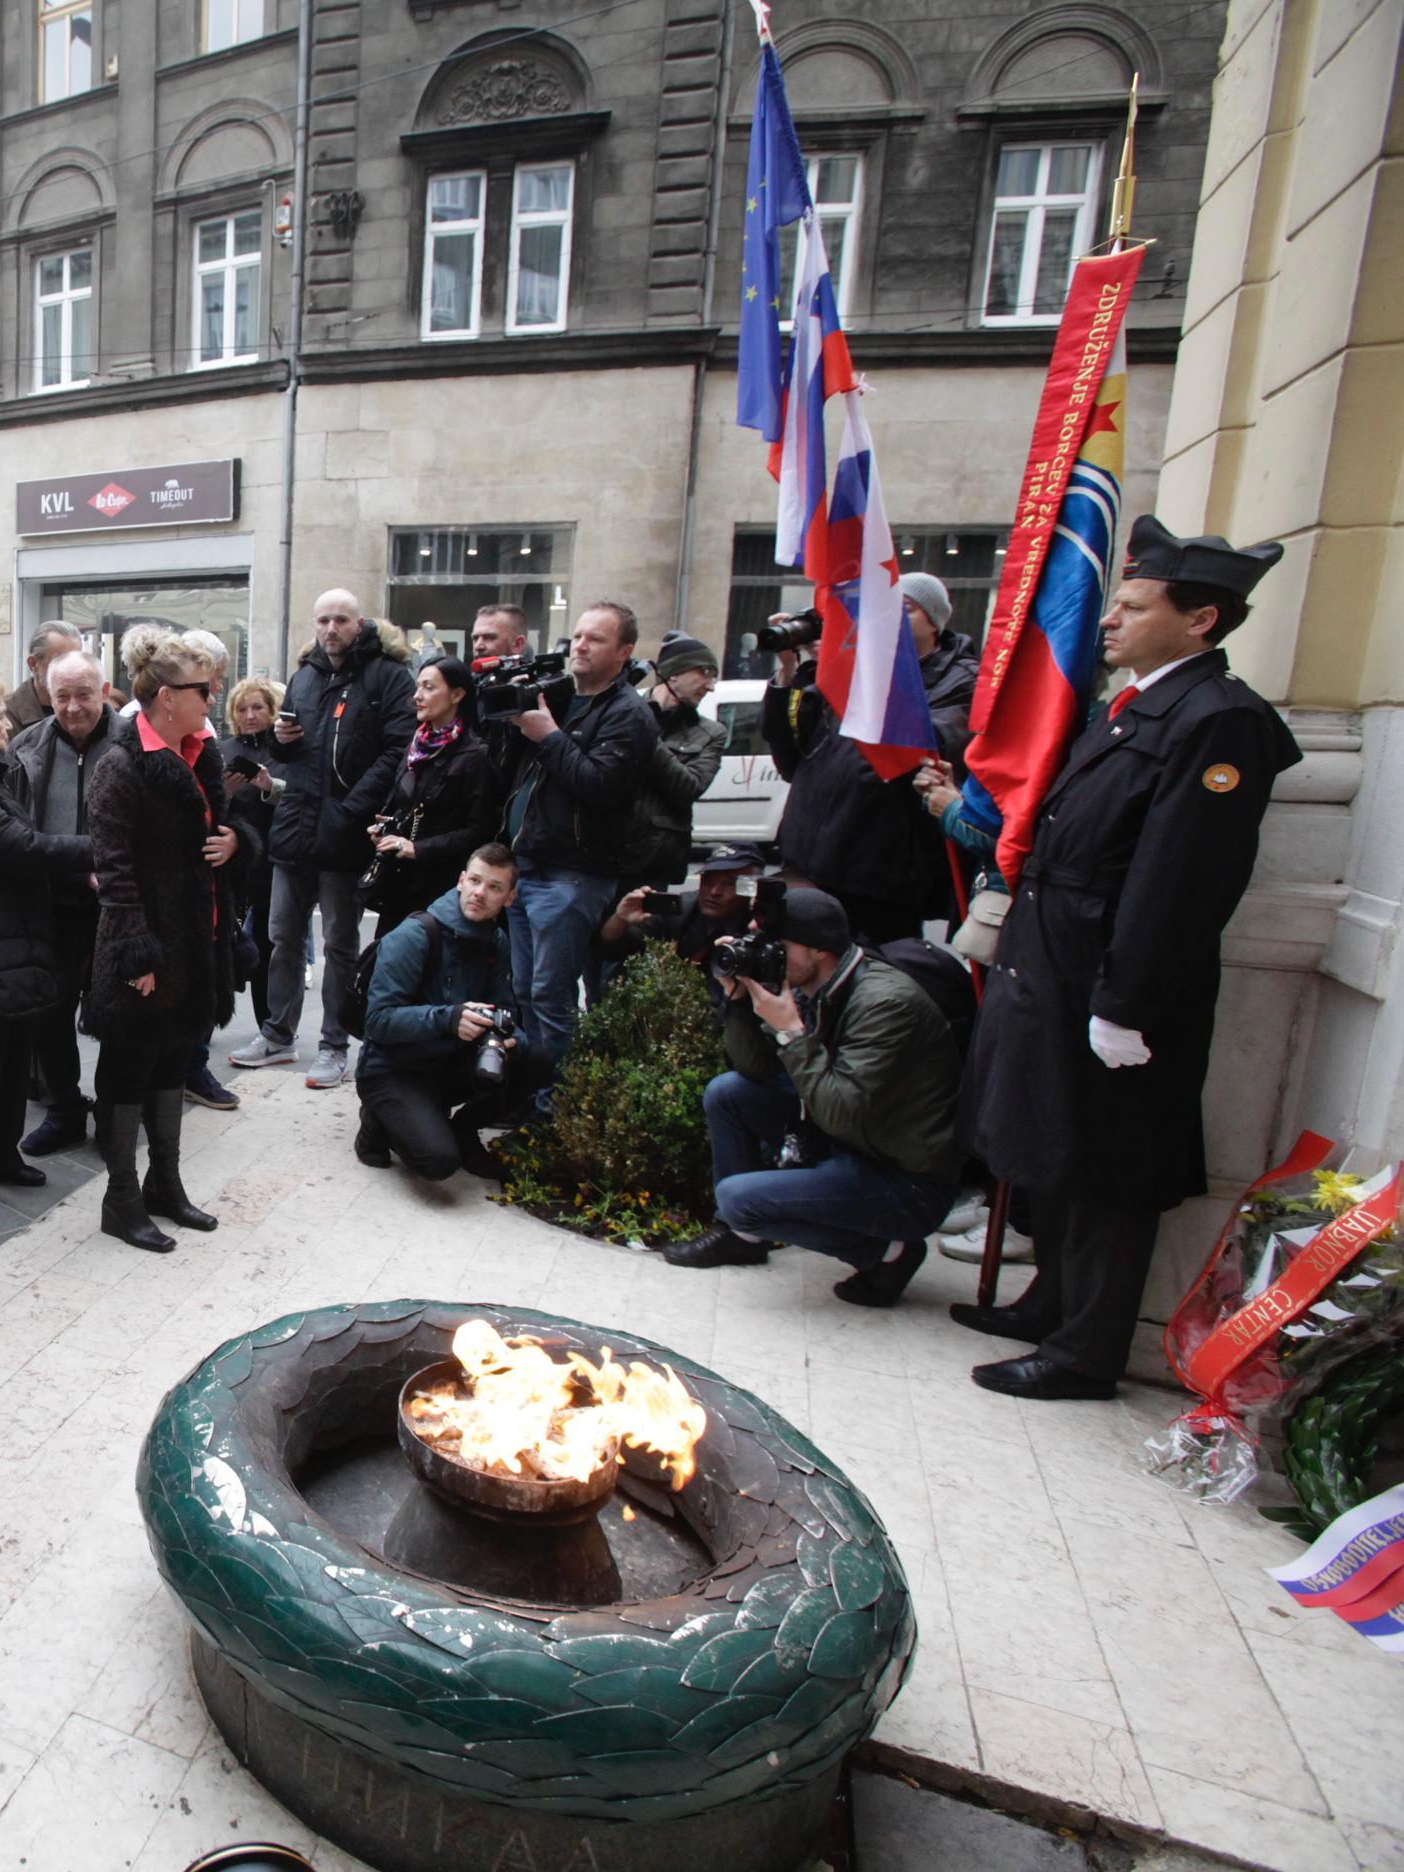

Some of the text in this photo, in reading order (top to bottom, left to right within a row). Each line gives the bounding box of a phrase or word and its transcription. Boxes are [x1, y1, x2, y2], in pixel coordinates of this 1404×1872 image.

[1068, 281, 1122, 406] ZDRUŽENJE
[1044, 410, 1080, 496] BORCEV
[40, 491, 74, 514] KVL
[150, 488, 194, 504] TIMEOUT
[1020, 461, 1049, 529] PIRAN
[1035, 503, 1052, 528] ZA
[1003, 535, 1044, 643] VREDNOTE
[1302, 1208, 1382, 1273] UABNOR
[1220, 1288, 1294, 1346] CENTAR
